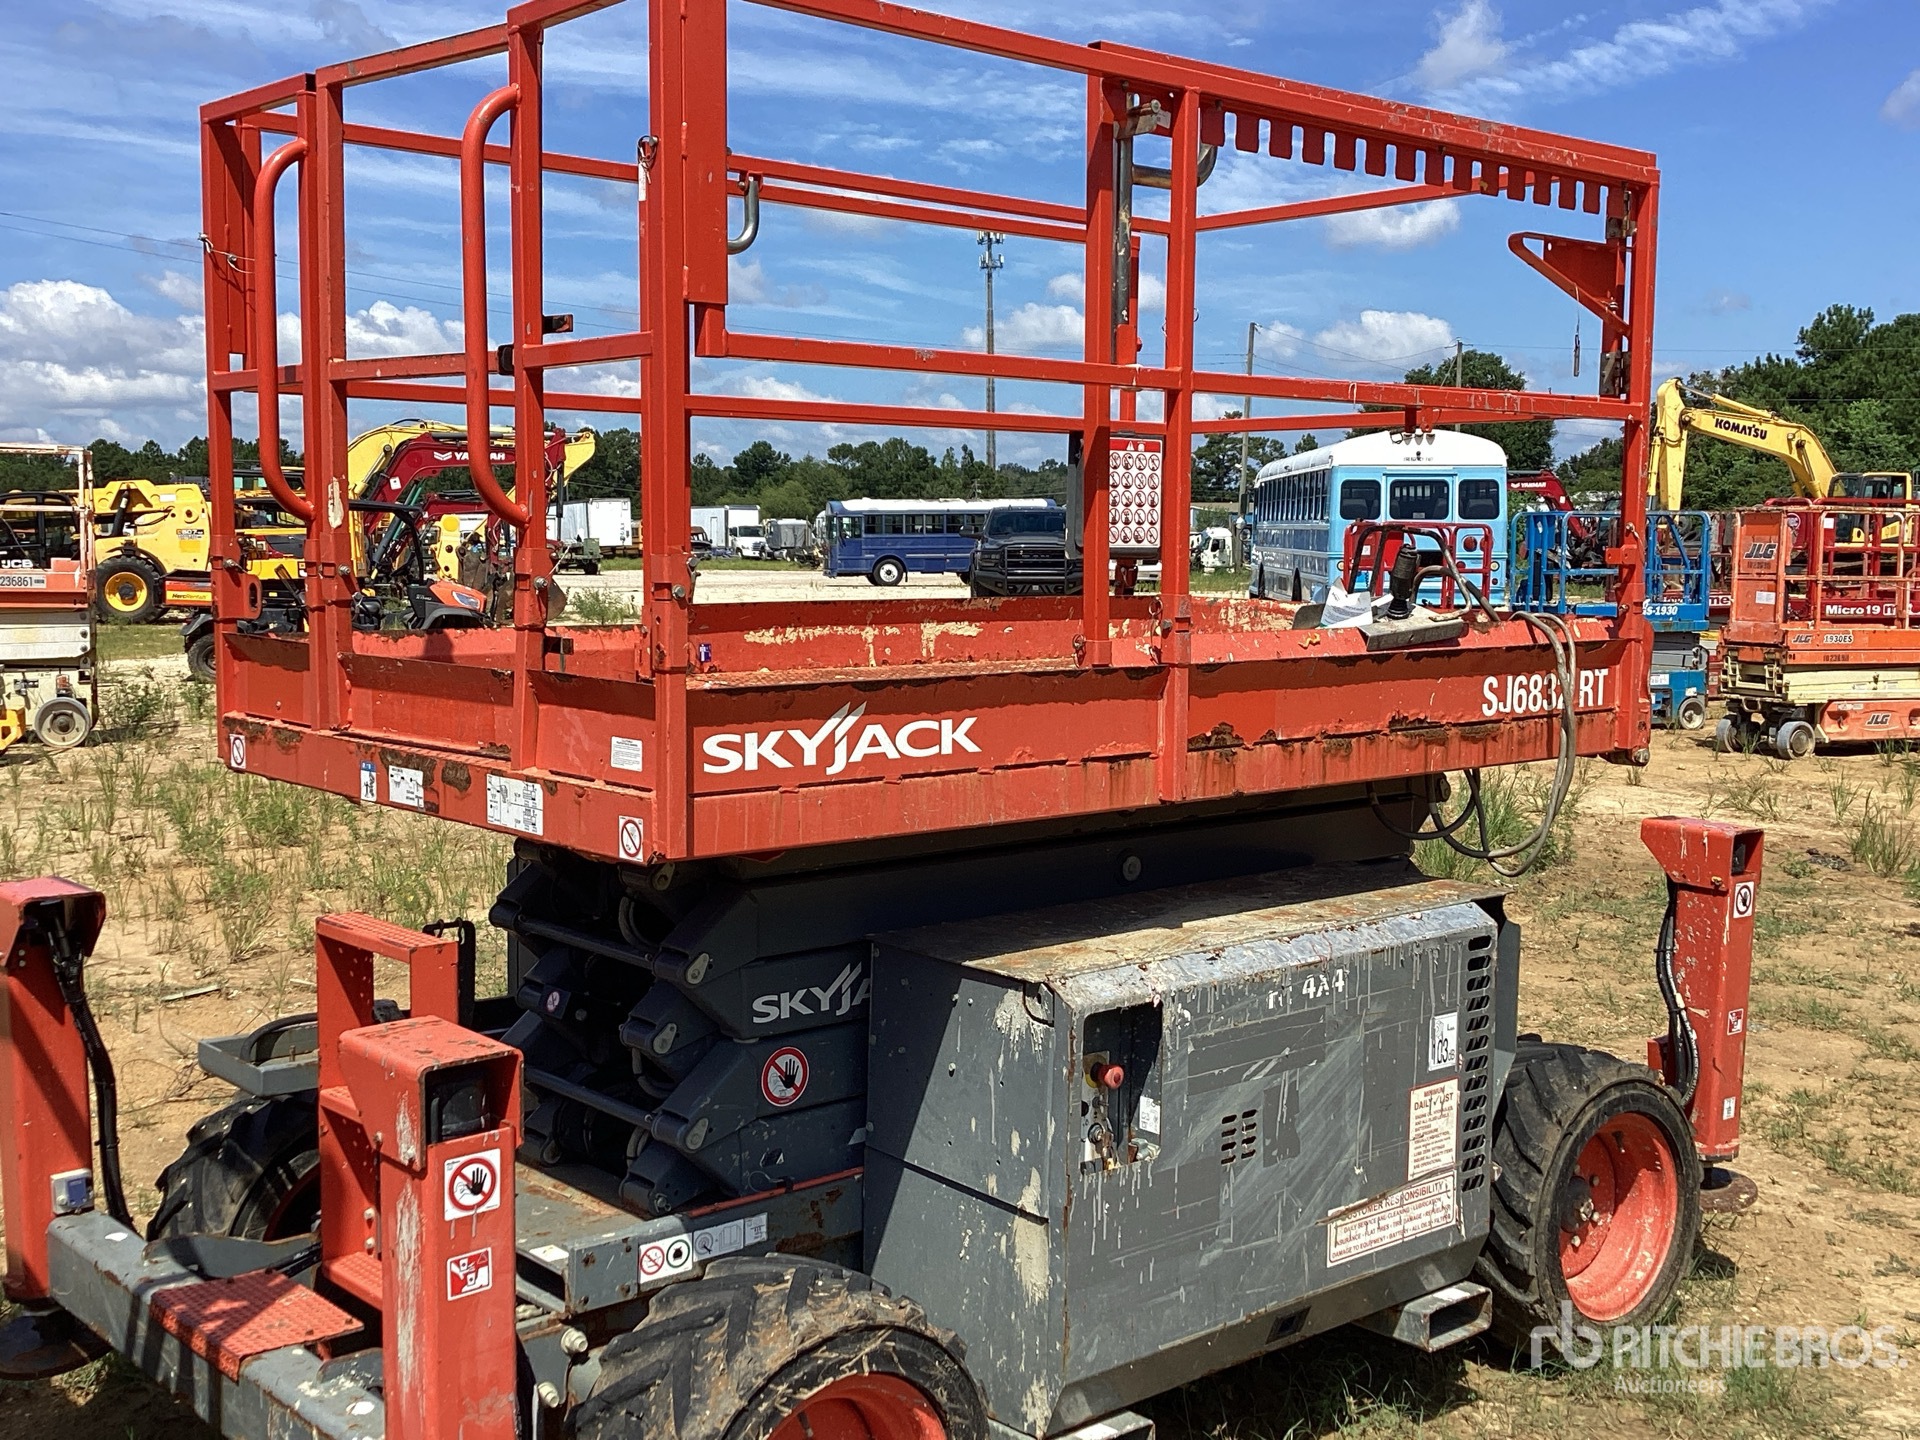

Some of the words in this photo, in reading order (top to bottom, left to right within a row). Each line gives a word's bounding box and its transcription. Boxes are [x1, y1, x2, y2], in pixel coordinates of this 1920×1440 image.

[1715, 418, 1767, 440] KOMATSU
[454, 452, 506, 461] YAAR
[1743, 543, 1777, 559] JLG
[1, 559, 33, 569] JCB
[1792, 634, 1812, 643] JLG
[1823, 634, 1853, 643] 1930ES
[1579, 668, 1608, 708] RT
[1867, 713, 1890, 726] JLG
[703, 701, 982, 775] SKYJACK
[752, 963, 871, 1023] SKYJA
[1414, 1098, 1432, 1110] DAILY
[1342, 1201, 1383, 1221] USTOMER
[1385, 1181, 1443, 1207] RESPONSIBILITY
